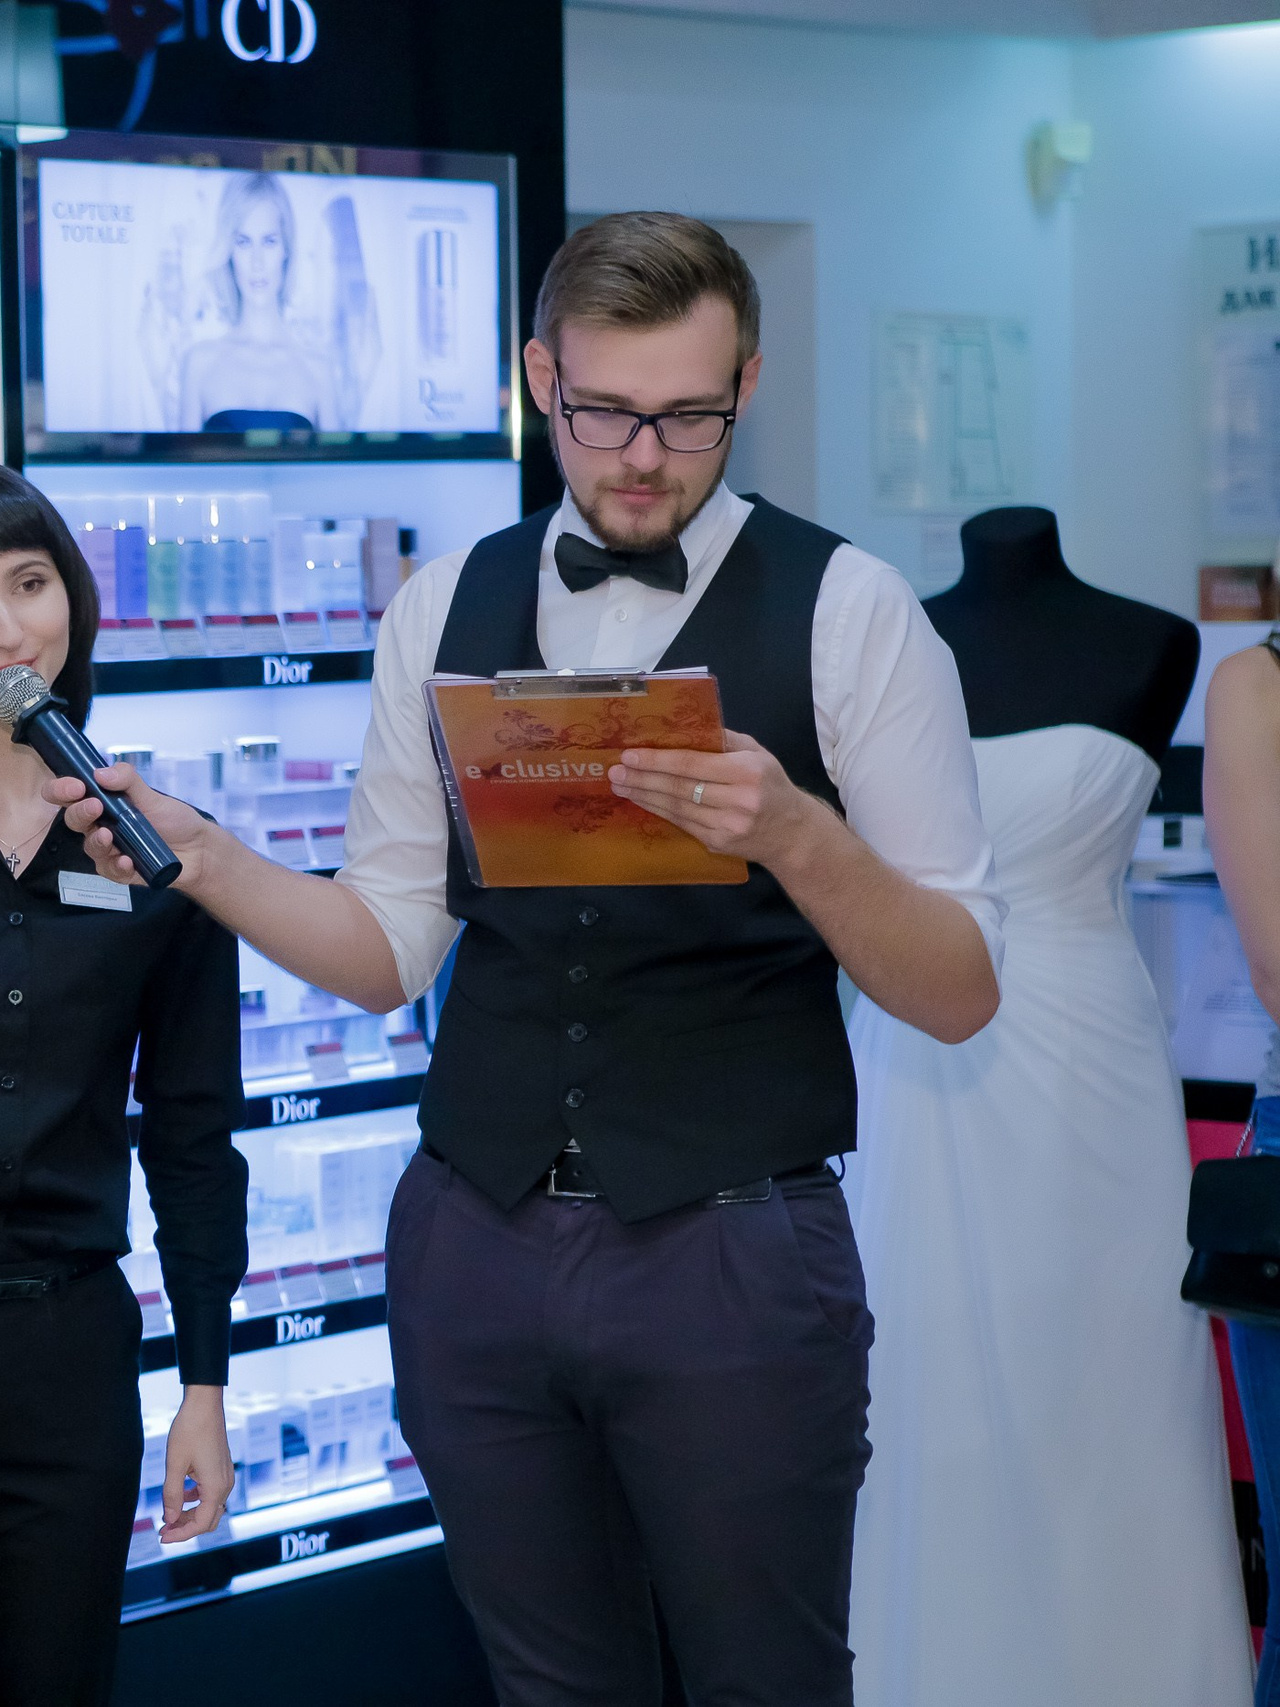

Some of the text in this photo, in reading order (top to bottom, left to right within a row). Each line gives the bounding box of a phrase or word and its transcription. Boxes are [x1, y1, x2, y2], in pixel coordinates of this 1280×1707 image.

[52, 201, 135, 222] CAPTURE
[262, 657, 314, 685] Dior
[465, 759, 604, 780] eclusive
[271, 1095, 320, 1125] Dior
[276, 1313, 326, 1344] Dior
[280, 1530, 330, 1562] Dior
